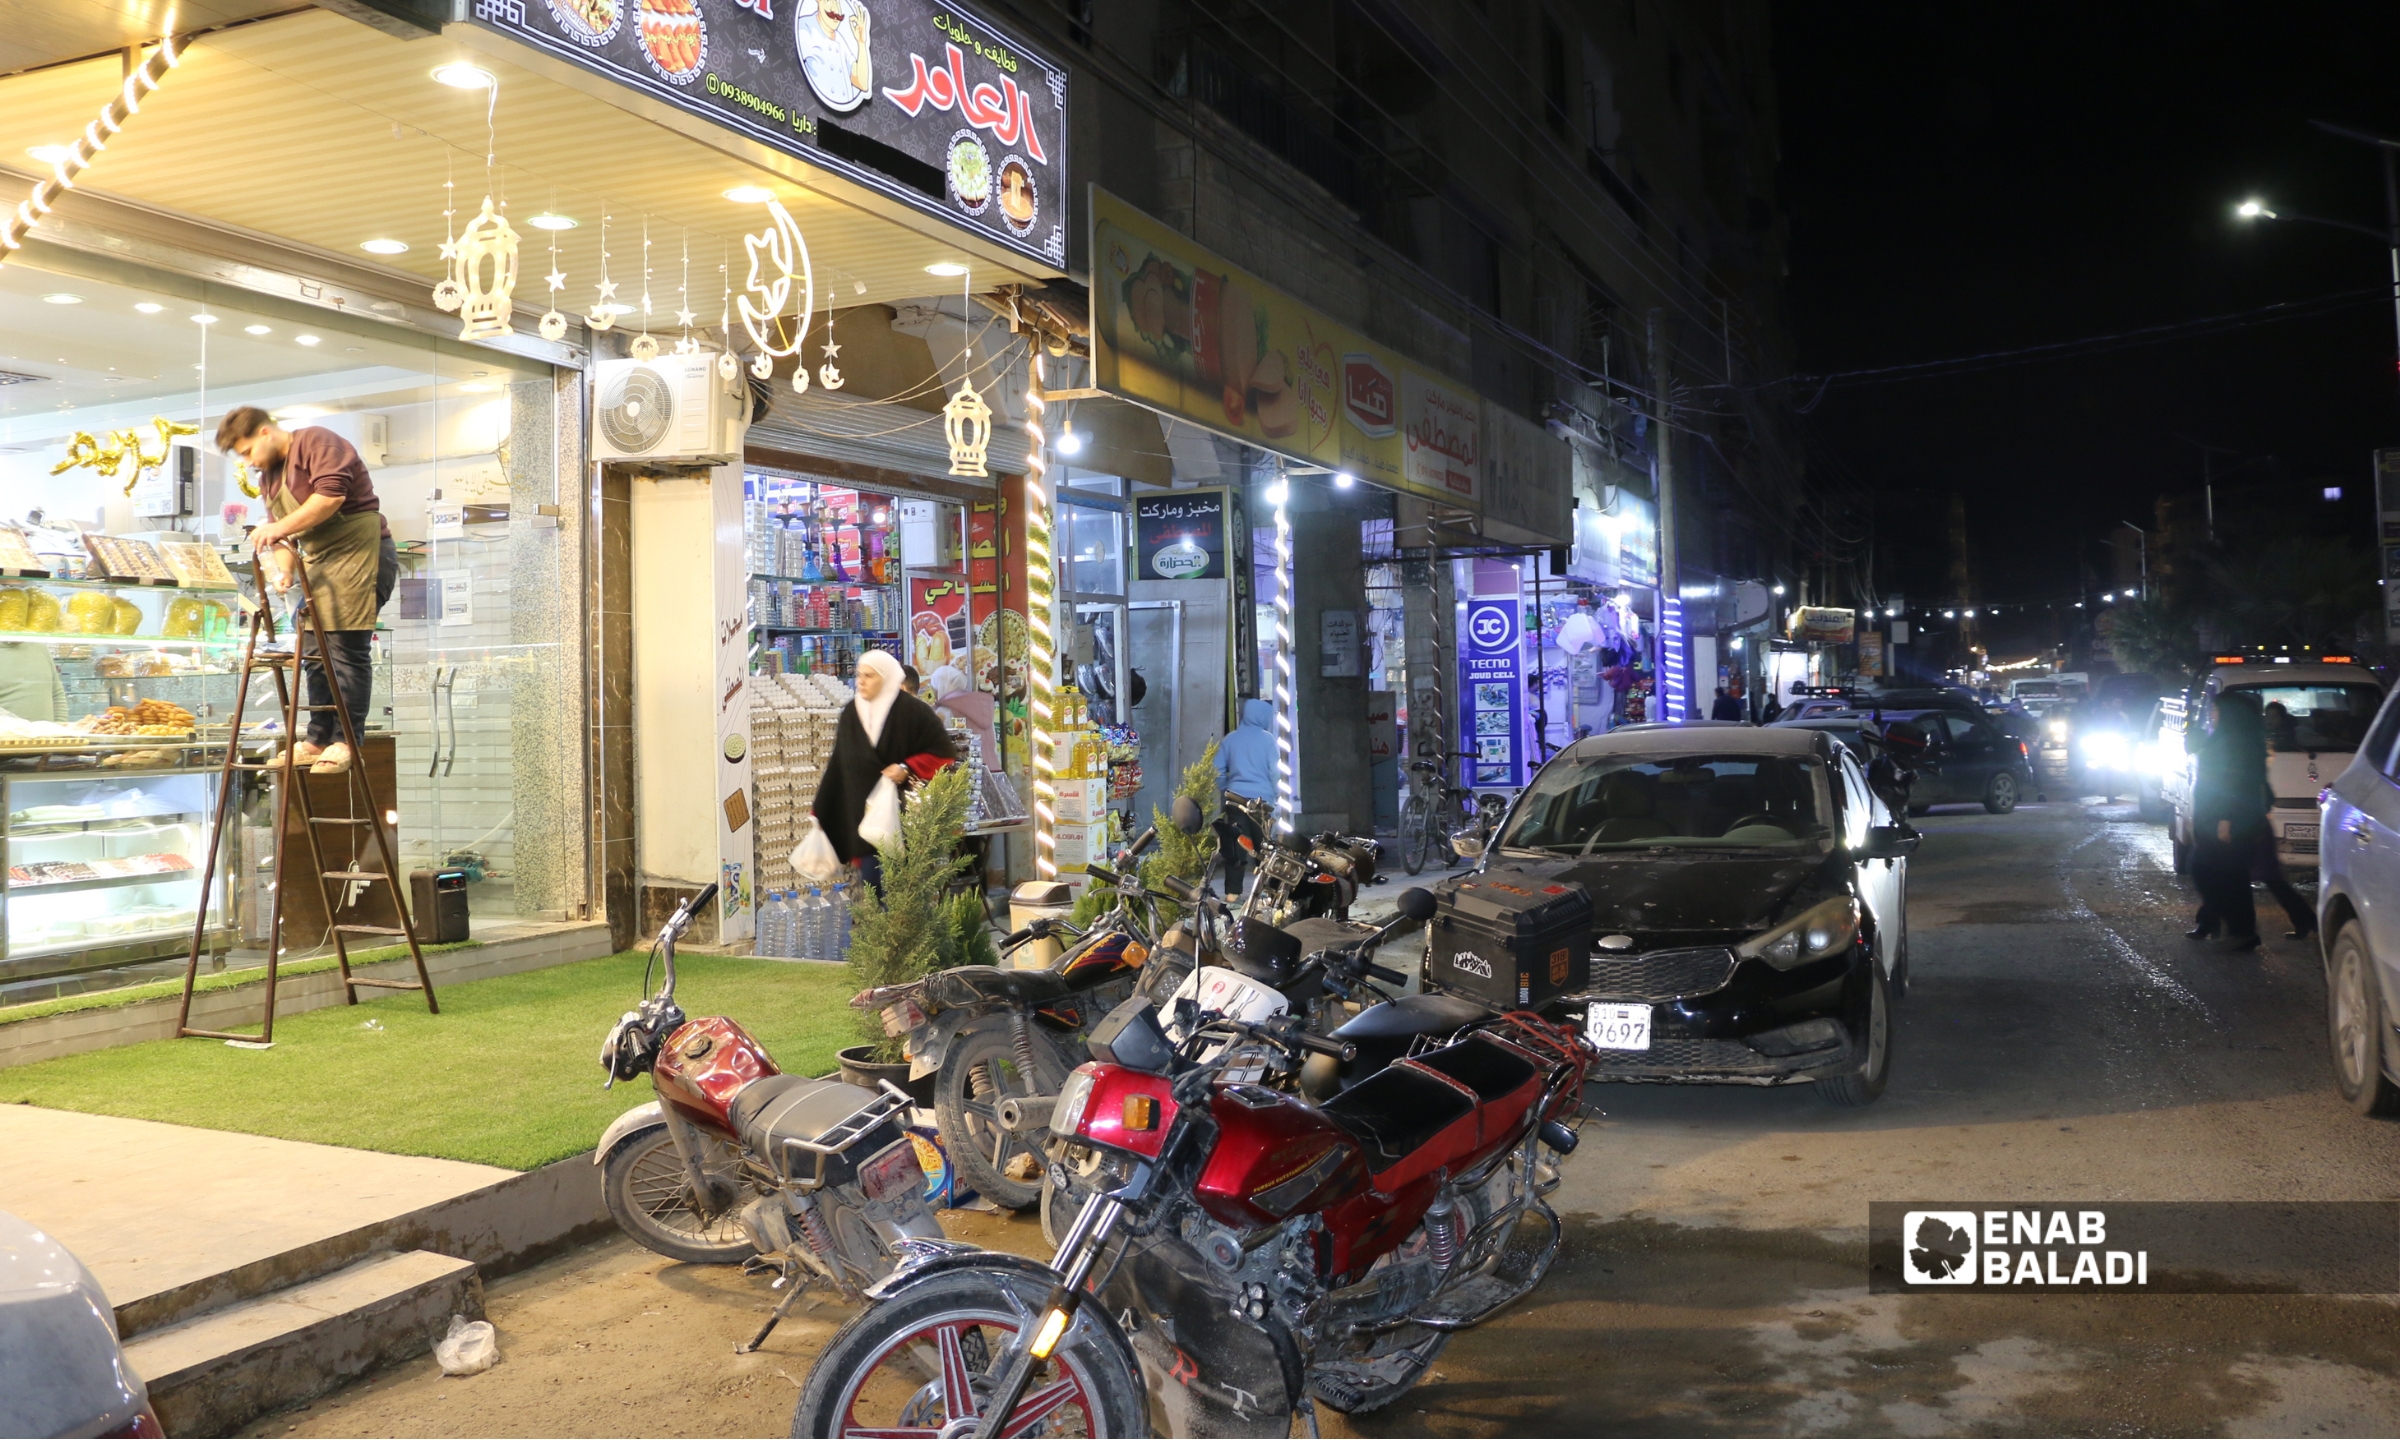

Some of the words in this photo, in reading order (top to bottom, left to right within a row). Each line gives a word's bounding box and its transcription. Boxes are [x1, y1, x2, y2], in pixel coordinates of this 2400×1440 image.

[932, 14, 973, 45] حلويات
[974, 41, 982, 55] و
[720, 81, 786, 122] 0938904966
[882, 41, 1047, 165] العامر
[1406, 407, 1478, 467] المصطفى
[1139, 503, 1184, 519] وماركت
[1185, 500, 1220, 517] مخبز
[1149, 522, 1212, 545] المصطفى
[1477, 618, 1502, 635] JC
[1469, 658, 1511, 669] TECNO
[1469, 672, 1492, 680] JOUD
[1493, 671, 1515, 679] CELL
[1520, 972, 1529, 987] 318
[1593, 1021, 1645, 1045] 9697
[1253, 1179, 1276, 1193] PURSUE
